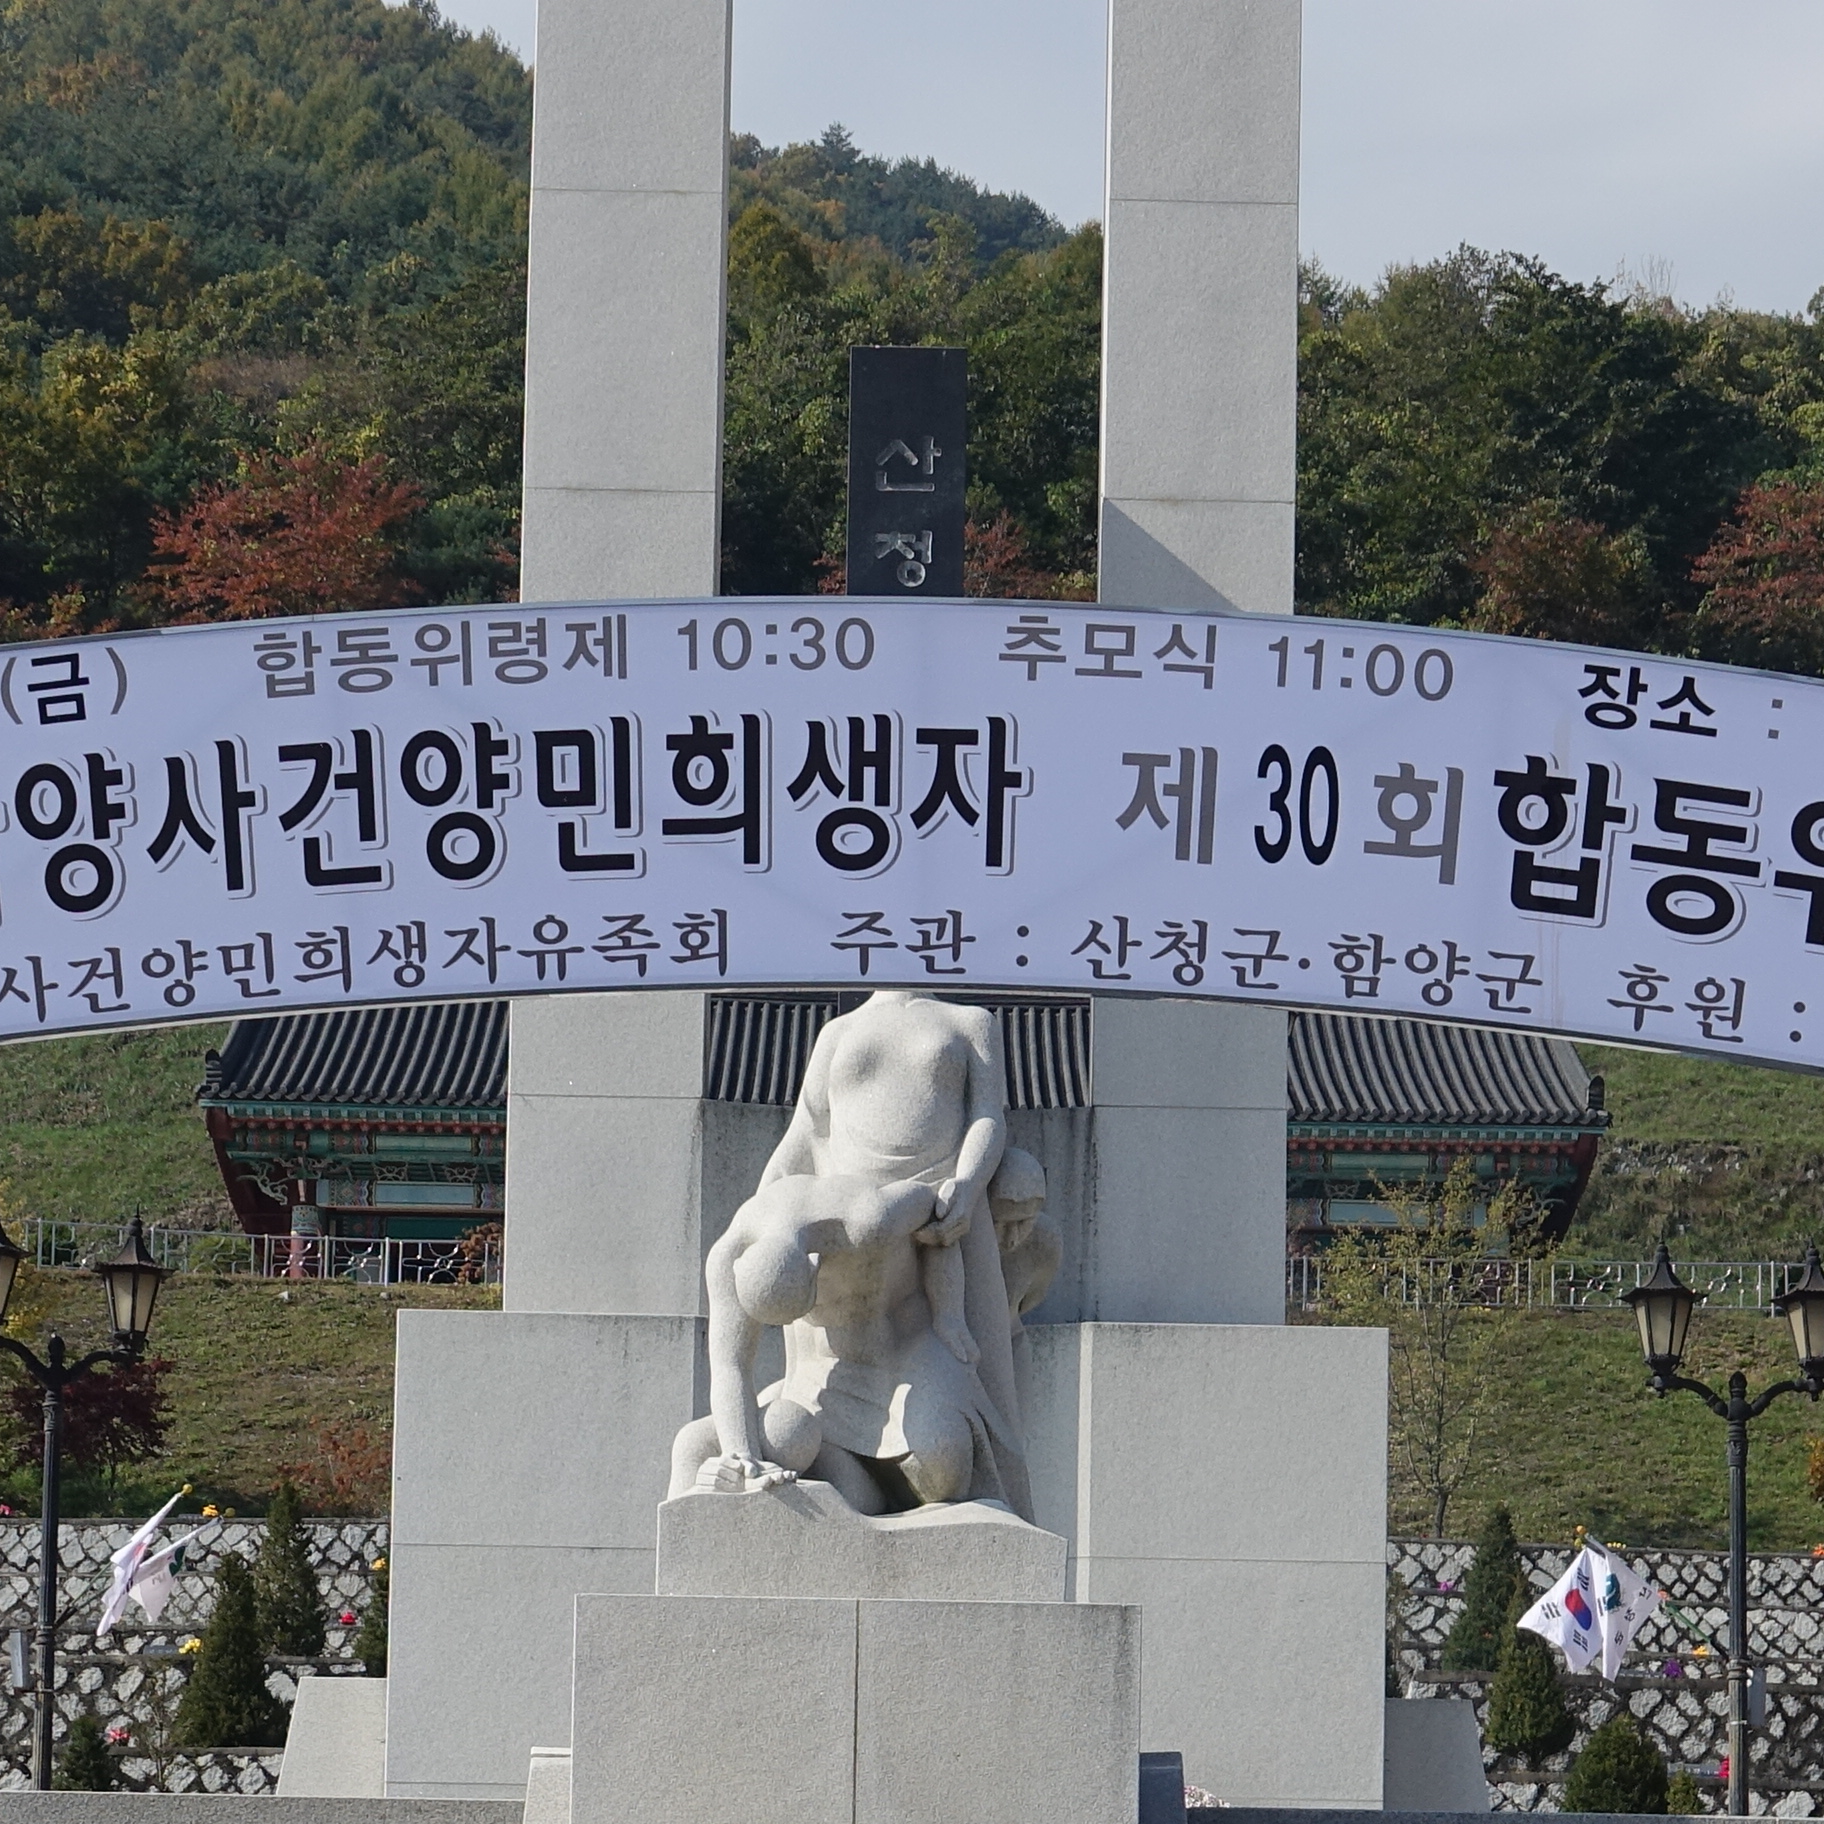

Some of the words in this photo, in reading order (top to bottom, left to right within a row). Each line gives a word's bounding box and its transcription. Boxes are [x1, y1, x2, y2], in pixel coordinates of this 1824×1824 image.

[252, 613, 628, 699] 합동위령제
[676, 616, 876, 673] 10:30
[998, 615, 1219, 690] 추모식
[1268, 635, 1455, 702] 11:00
[1576, 663, 1719, 738] 장소
[830, 908, 976, 977] 주관
[1607, 963, 1748, 1045] 후원
